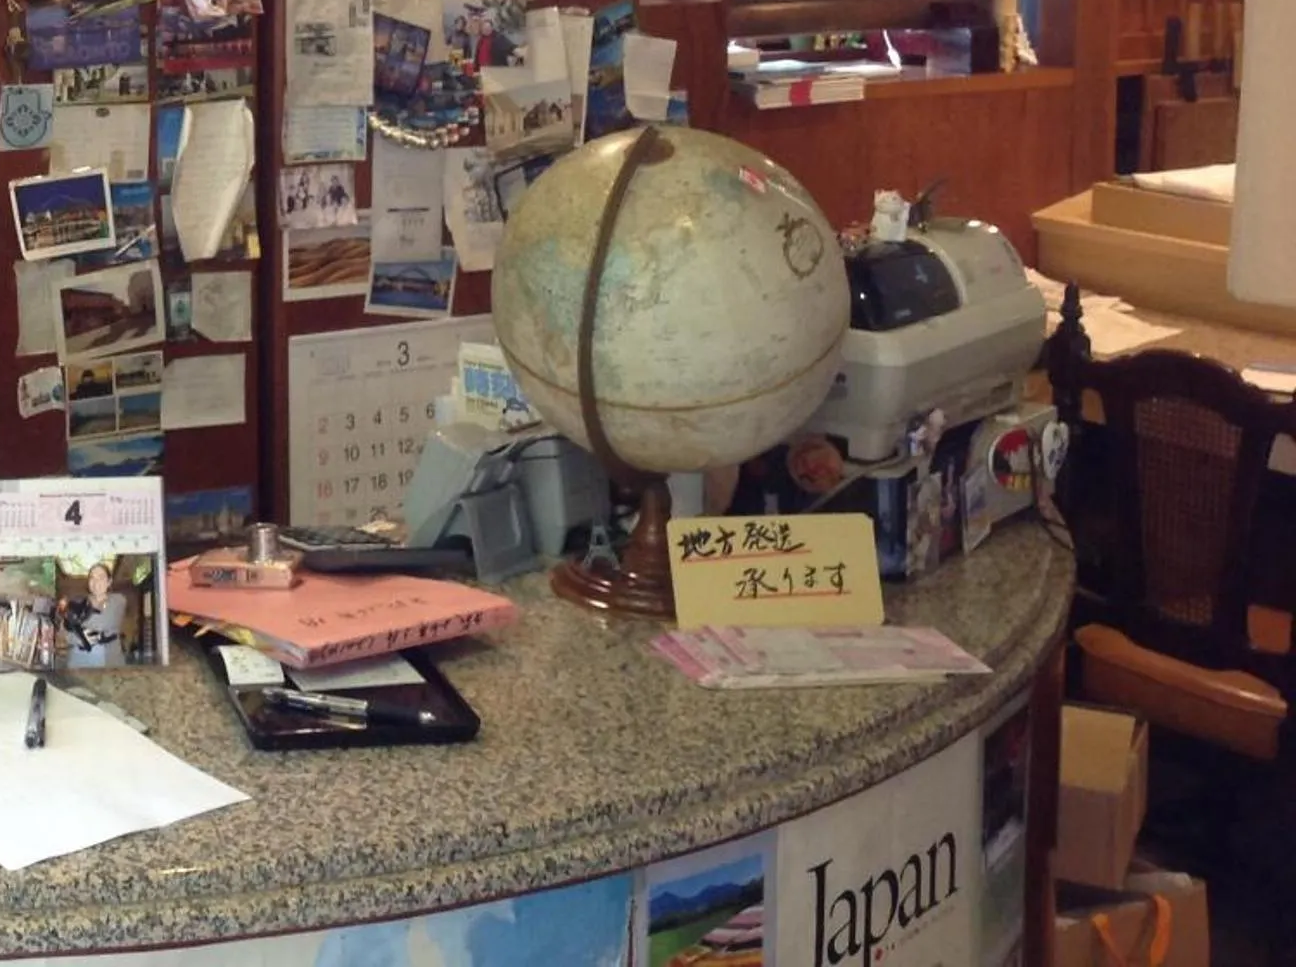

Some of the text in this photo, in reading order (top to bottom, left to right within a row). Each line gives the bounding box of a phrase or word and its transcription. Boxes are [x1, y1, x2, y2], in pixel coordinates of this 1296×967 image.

[397, 340, 410, 366] 3
[345, 414, 355, 431] 3
[373, 410, 382, 425] 4
[399, 406, 409, 423] 5
[426, 403, 436, 420] 6
[344, 445, 360, 462] 10
[371, 443, 385, 457] 11
[398, 439, 414, 455] 12
[344, 477, 360, 494] 17
[371, 473, 388, 490] 18
[65, 499, 83, 526] 4
[678, 521, 805, 561] 地方発送
[735, 562, 848, 599] 承ります
[806, 832, 959, 967] Japan
